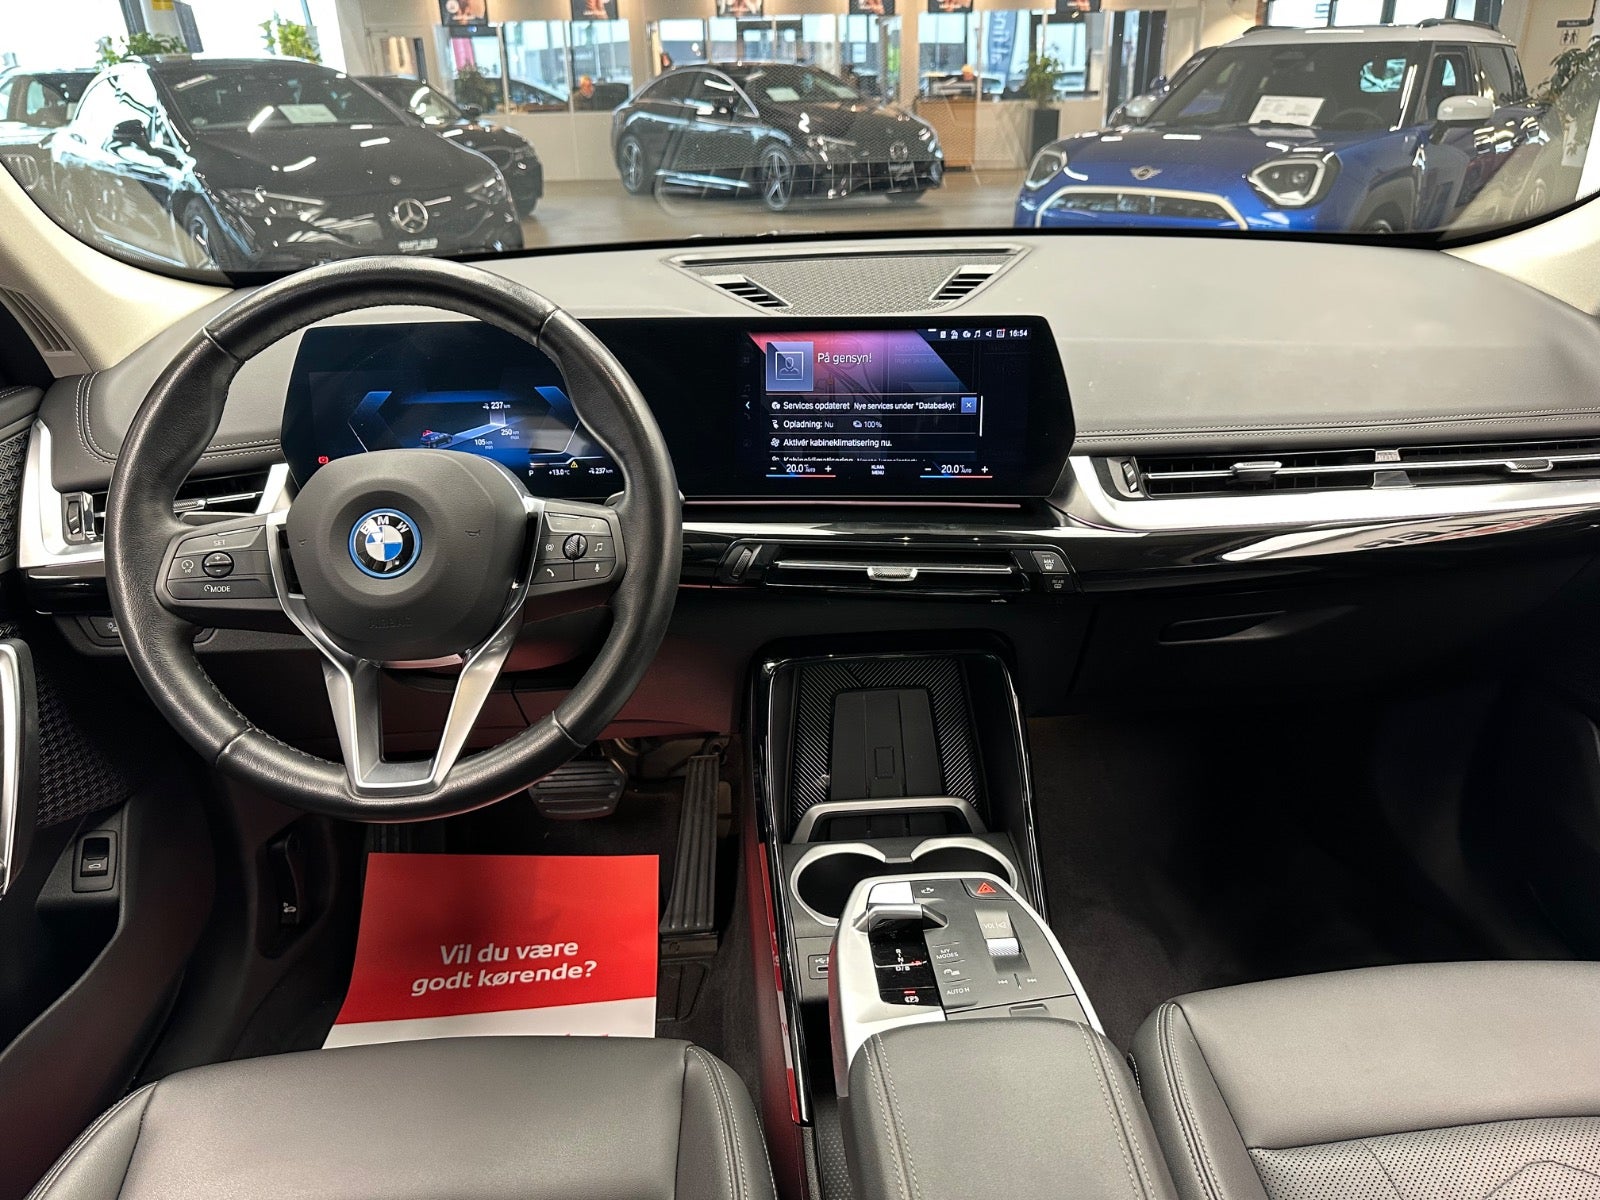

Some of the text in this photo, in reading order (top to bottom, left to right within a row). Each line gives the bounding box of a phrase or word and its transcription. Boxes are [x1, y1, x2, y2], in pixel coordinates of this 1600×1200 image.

[1009, 329, 1028, 337] 16:54
[817, 352, 872, 365] På gensyn!
[490, 401, 504, 410] 237
[783, 401, 850, 411] Services opdateret
[853, 402, 866, 410] Nye
[867, 402, 894, 410] services
[894, 402, 914, 410] under
[783, 420, 823, 430] Opladning:
[864, 421, 883, 429] 100%
[501, 428, 513, 436] 250
[783, 438, 893, 449] Aktivér kabineklimatisering nu.
[786, 463, 804, 473] 20.0
[941, 464, 960, 474] 20.0
[360, 515, 410, 535] BMW
[210, 585, 231, 593] MODE
[440, 941, 579, 965] Vil du være
[936, 952, 959, 960] MODES
[410, 960, 598, 997] godt kørende?
